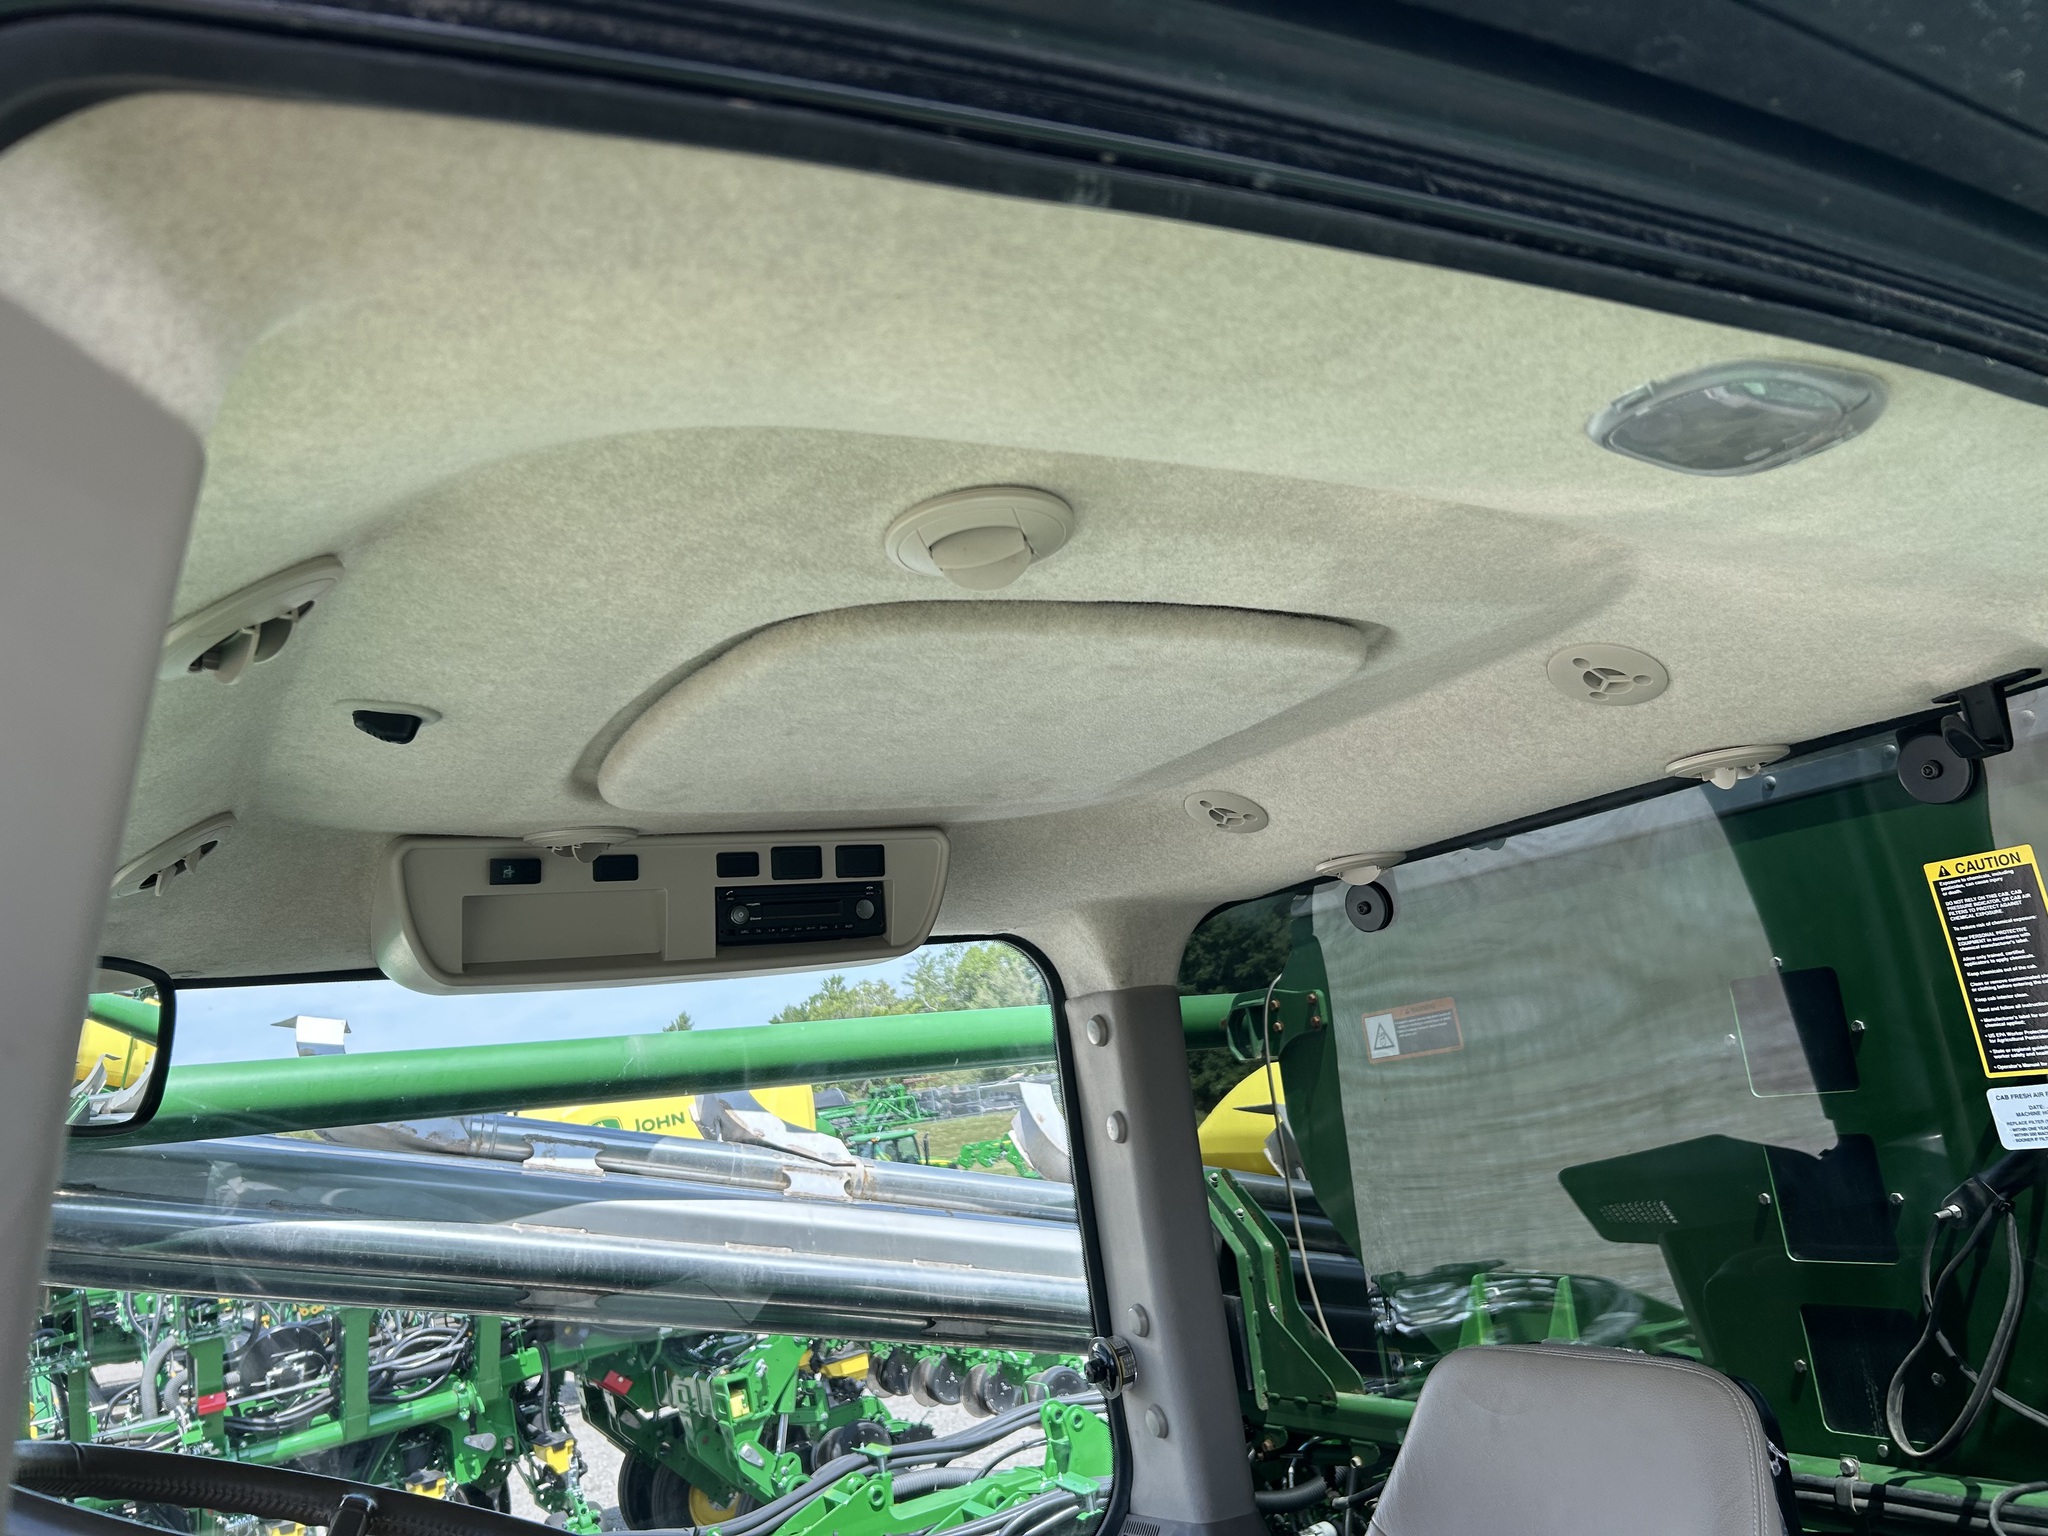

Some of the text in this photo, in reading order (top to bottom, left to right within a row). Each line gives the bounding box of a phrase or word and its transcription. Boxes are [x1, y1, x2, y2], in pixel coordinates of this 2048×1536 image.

[1955, 852, 2021, 874] CAUTION
[1947, 903, 1973, 911] PRESSURE
[635, 1112, 685, 1131] JOHN
